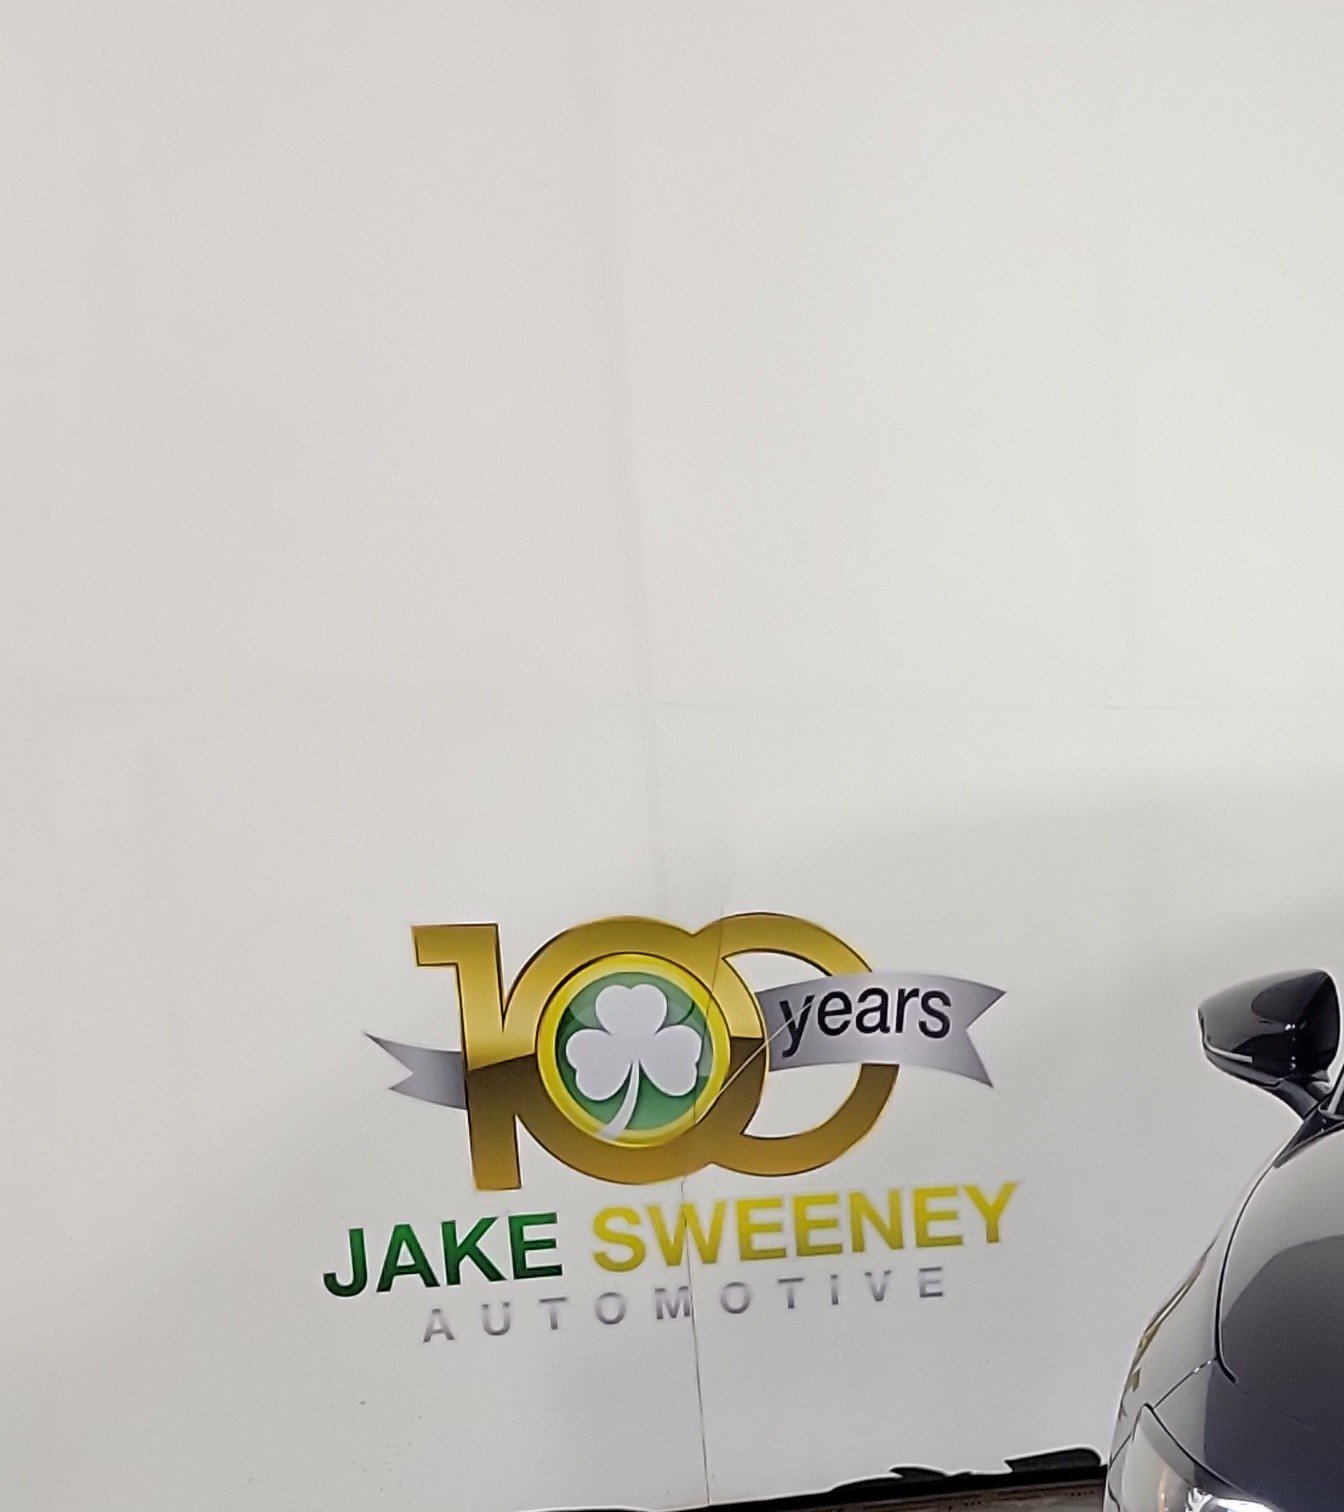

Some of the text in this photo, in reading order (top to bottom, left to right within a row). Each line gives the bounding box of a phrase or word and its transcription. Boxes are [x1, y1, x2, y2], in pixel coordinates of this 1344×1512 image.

[411, 912, 952, 1192] 100 years
[322, 1182, 1019, 1297] JAKE SWEENEY
[422, 1266, 945, 1343] AUTOMOTIVE
